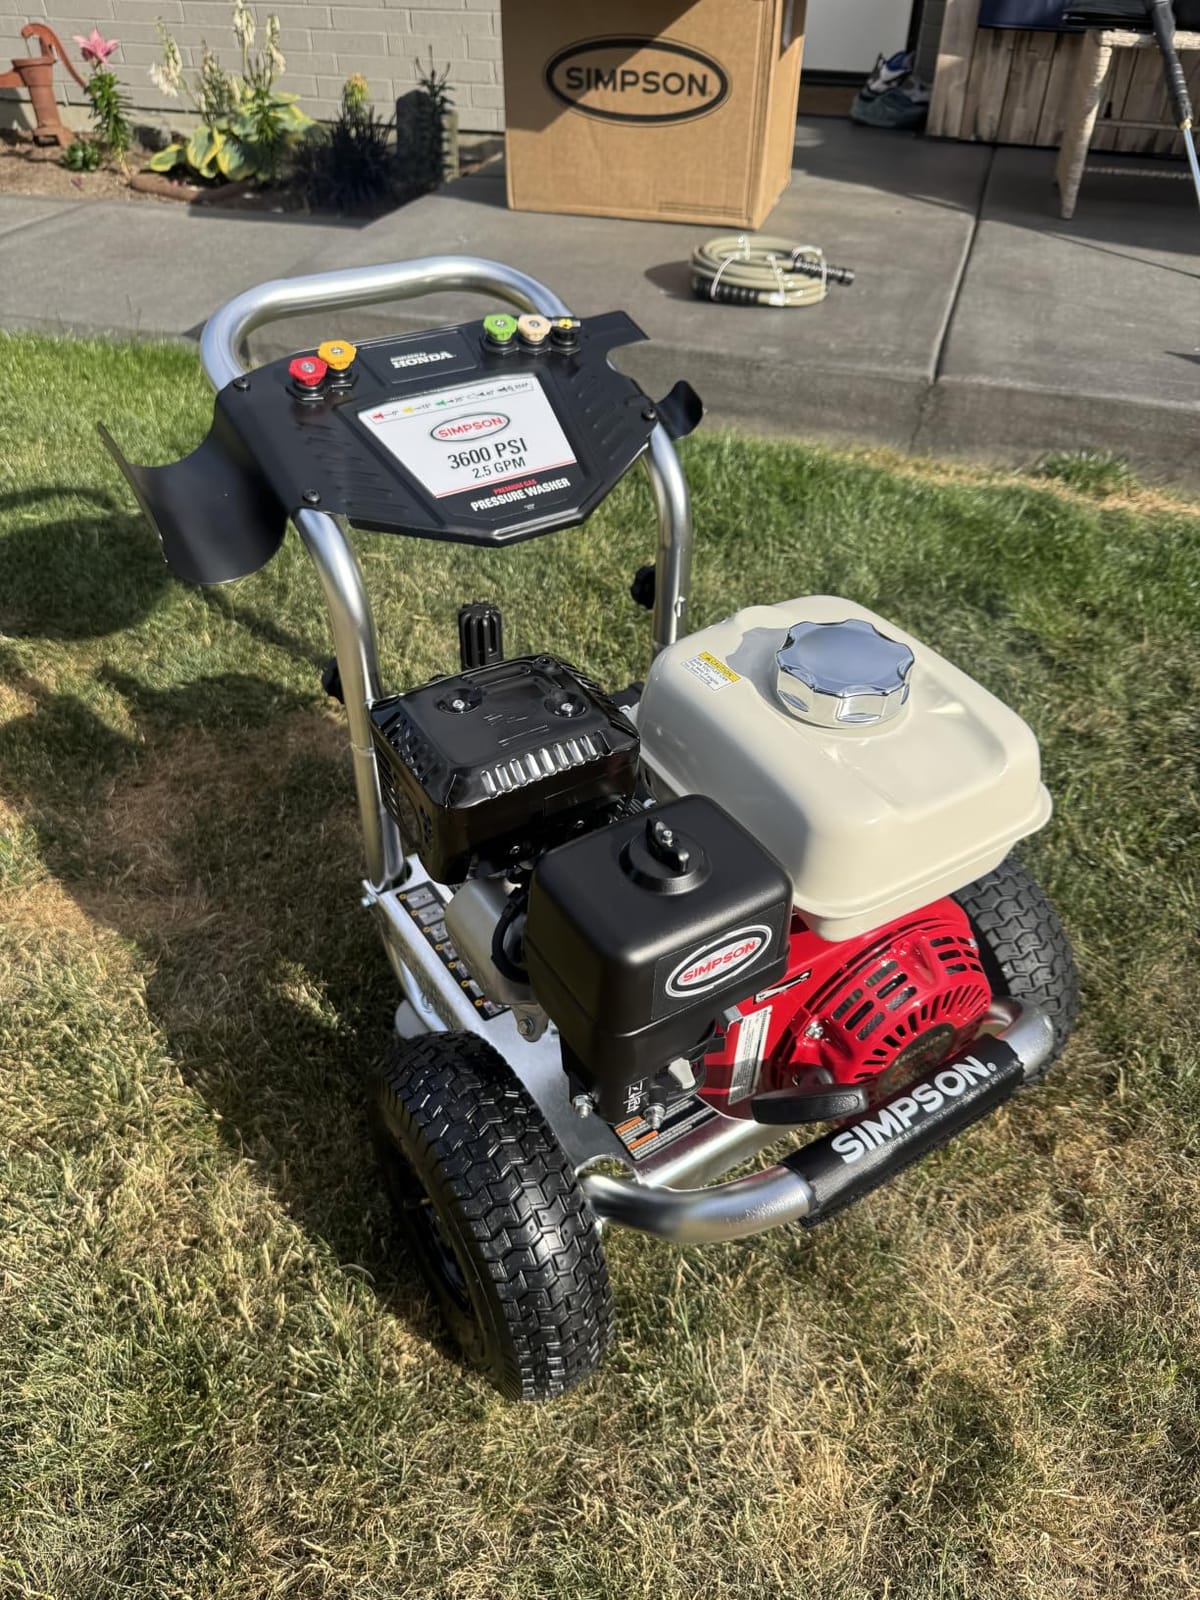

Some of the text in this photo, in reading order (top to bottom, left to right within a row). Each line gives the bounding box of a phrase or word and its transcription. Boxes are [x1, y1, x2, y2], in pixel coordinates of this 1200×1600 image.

[565, 67, 708, 97] SIMPSON
[391, 351, 454, 369] HONDA
[438, 417, 503, 438] SIMPSON
[447, 437, 528, 470] 3600 PSI
[471, 456, 526, 479] 2.5 GPM
[470, 477, 571, 512] PRESSURE WASHER
[683, 940, 756, 982] SIMPSON
